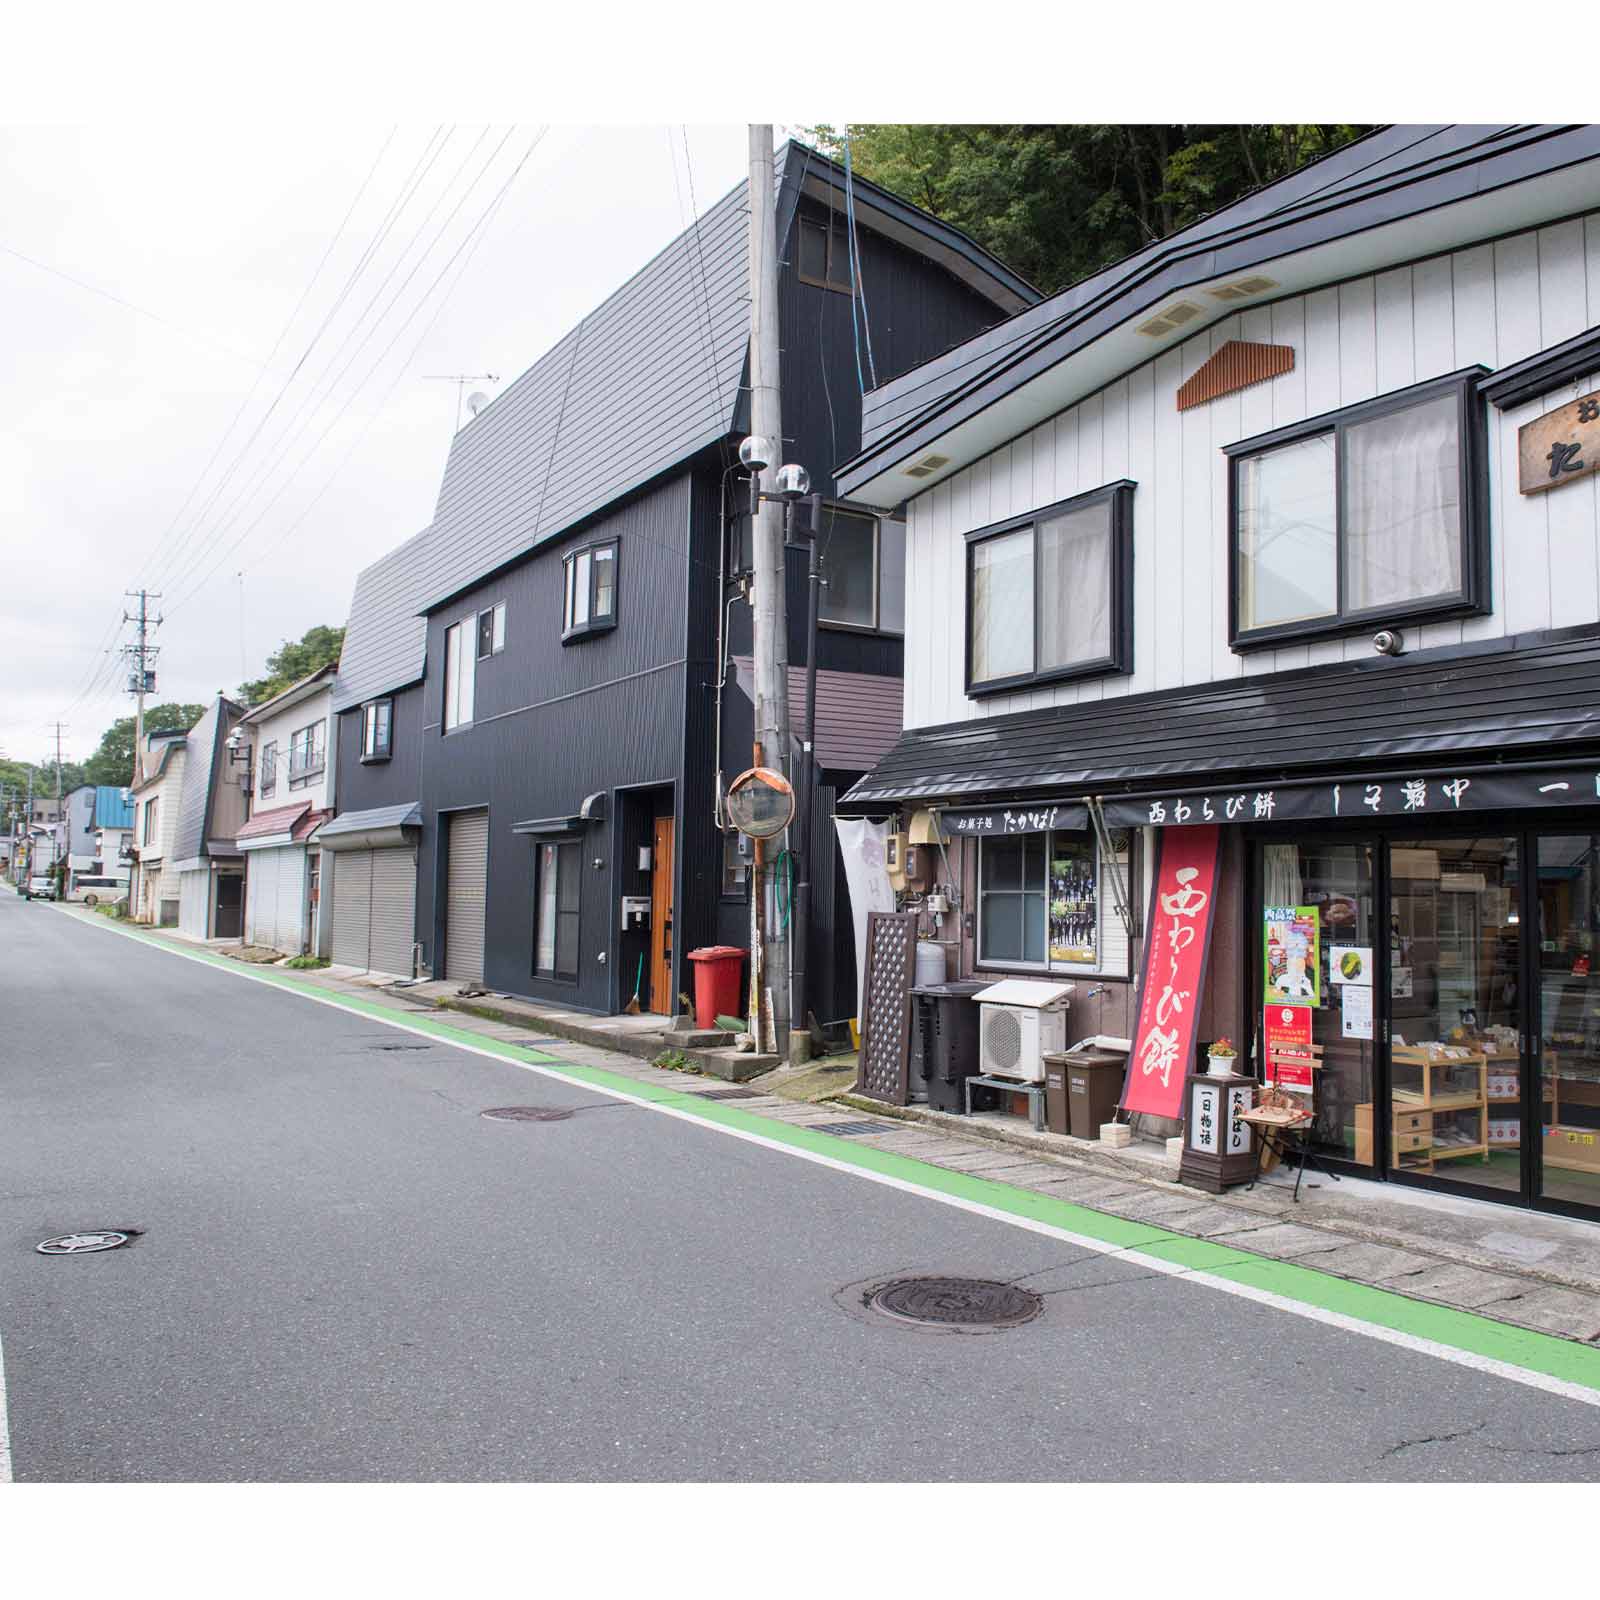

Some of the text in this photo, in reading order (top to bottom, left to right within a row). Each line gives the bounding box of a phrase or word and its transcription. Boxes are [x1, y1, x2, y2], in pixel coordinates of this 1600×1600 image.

[957, 807, 1058, 833] お菓子処 たかはし
[1149, 791, 1276, 823] 西わらび餅
[1538, 773, 1600, 798] 一
[1139, 866, 1208, 1088] 西わらび餅
[1200, 1091, 1213, 1145] 一日物語
[1232, 1091, 1244, 1147] たかはし
